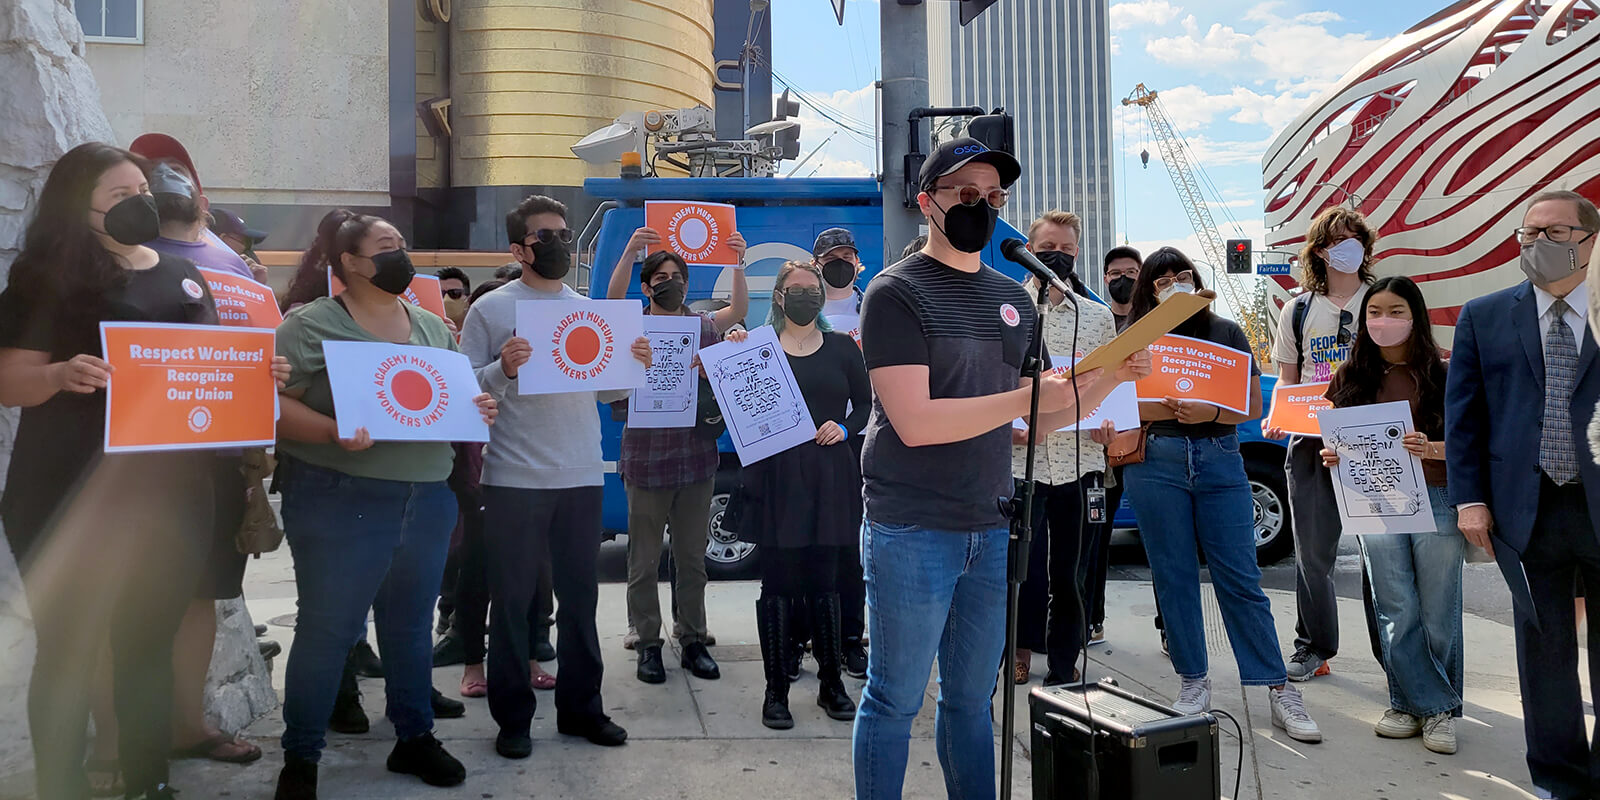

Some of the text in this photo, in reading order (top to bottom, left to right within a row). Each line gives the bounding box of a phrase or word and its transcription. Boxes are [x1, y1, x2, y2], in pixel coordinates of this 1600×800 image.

[668, 206, 719, 234] ACADEMY MUSEUM
[668, 234, 718, 261] WORKERS UNITED
[1259, 265, 1279, 273] Fairfax
[208, 280, 265, 303] Workers!
[215, 296, 246, 308] gnize
[552, 311, 614, 345] ACADEMY MUSEUM
[130, 344, 264, 363] Respect Workers!
[1148, 343, 1236, 367] espect Workers!
[552, 345, 614, 380] WORKERS UNITED
[737, 358, 754, 368] THE
[1162, 356, 1212, 370] Recognize
[1315, 362, 1331, 376] FOR
[167, 368, 234, 385] Recognize
[374, 354, 448, 390] ACADEMY MUSEUM
[730, 361, 769, 380] ARTFORM
[1161, 365, 1211, 379] Our Union
[745, 373, 760, 384] WE
[167, 387, 233, 400] Our Union
[375, 390, 449, 427] WORKERS UNITED
[750, 401, 778, 417] LABOR
[1357, 433, 1377, 442] THE
[1348, 441, 1394, 450] ARTFORM
[1364, 451, 1379, 459] WE
[1359, 467, 1404, 476] CREATED
[1362, 484, 1396, 492] LABOR
